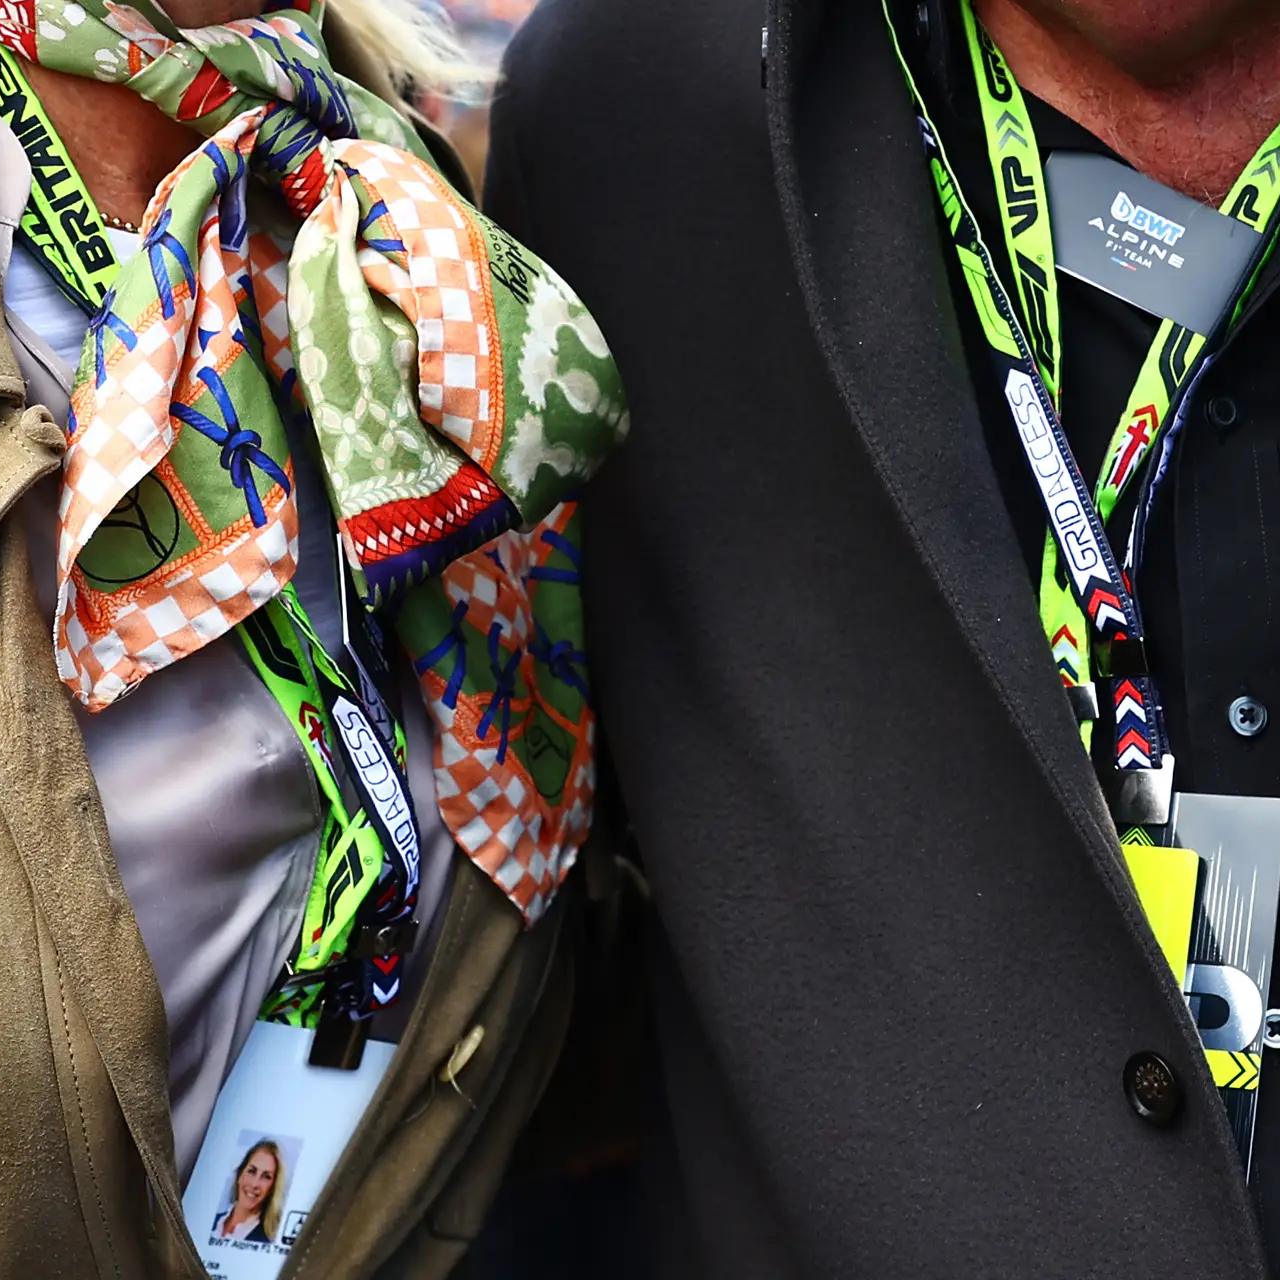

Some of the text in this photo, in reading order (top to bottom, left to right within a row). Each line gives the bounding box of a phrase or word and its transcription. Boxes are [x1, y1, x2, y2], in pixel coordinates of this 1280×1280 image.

[1001, 155, 1039, 239] VIP
[1088, 217, 1185, 269] ALPINE
[1130, 206, 1184, 246] BWT
[1123, 248, 1153, 269] TEAM
[1008, 382, 1099, 572] GRID ACCESS
[336, 710, 406, 821] ACCESS
[273, 1245, 291, 1256] Tea
